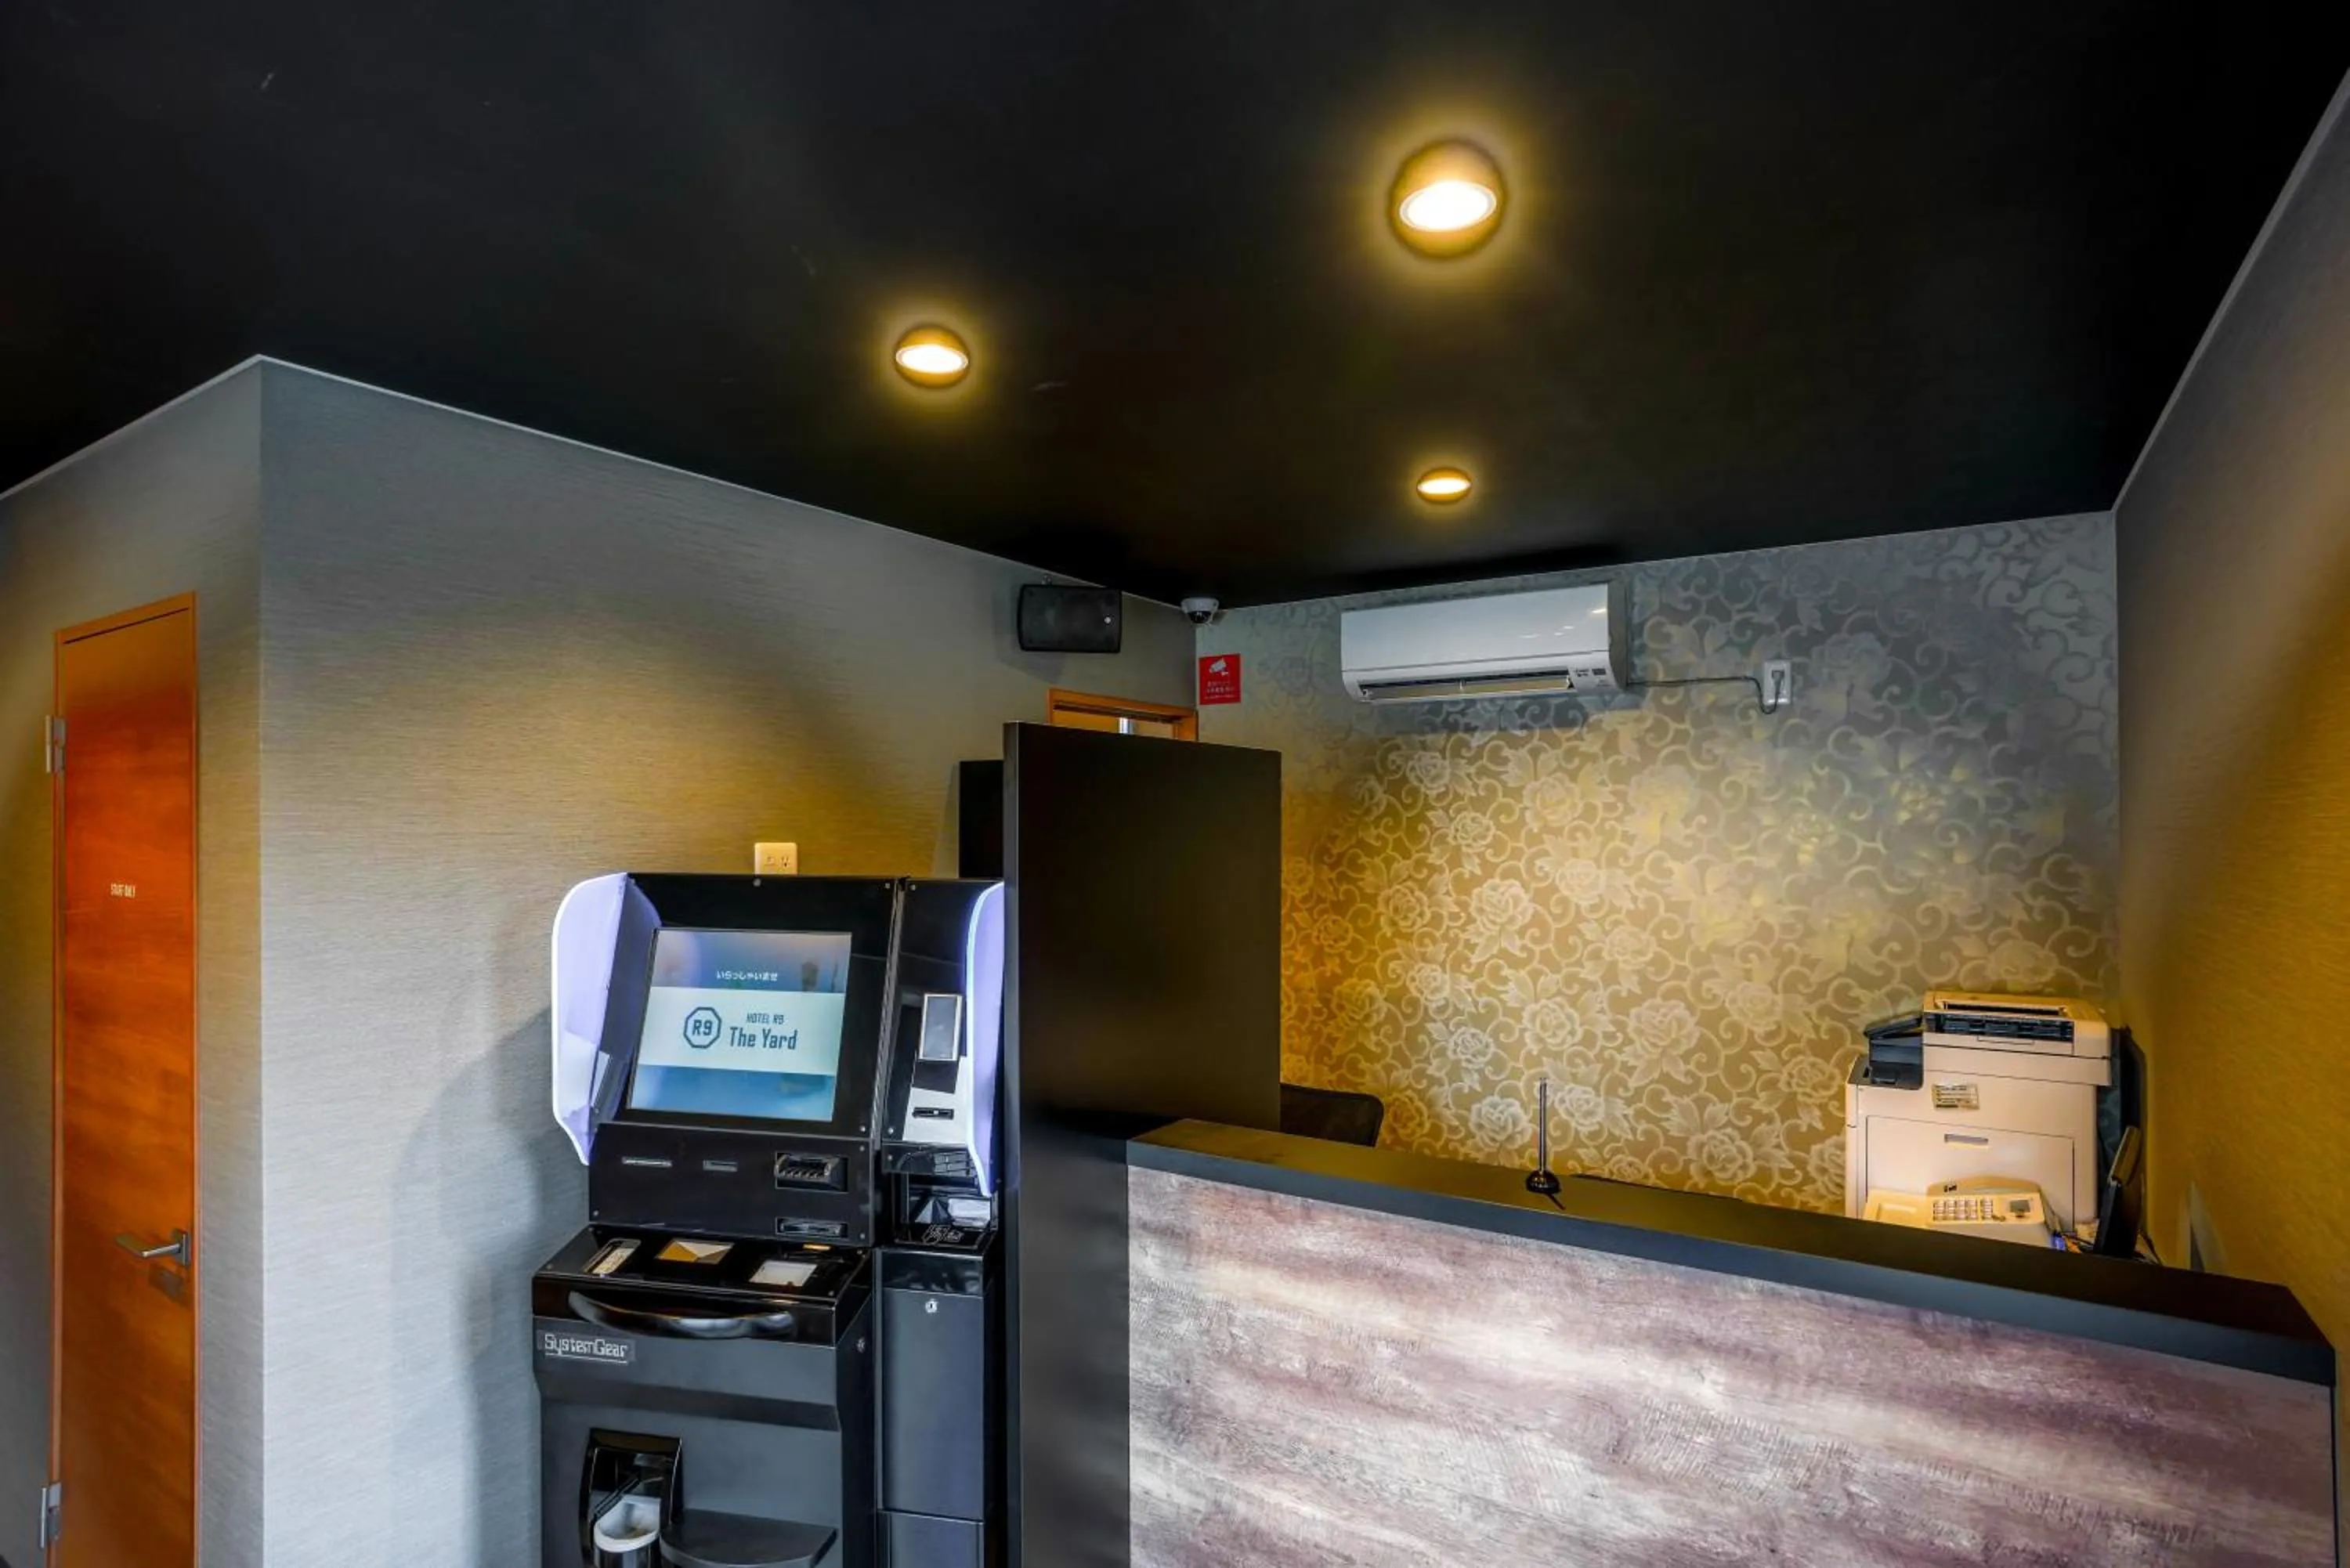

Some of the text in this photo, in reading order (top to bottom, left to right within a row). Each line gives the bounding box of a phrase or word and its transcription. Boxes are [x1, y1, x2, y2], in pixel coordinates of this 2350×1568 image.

[692, 1019, 714, 1036] R9
[747, 1013, 769, 1024] HOTEL
[729, 1027, 798, 1050] The Yard
[544, 1333, 627, 1358] SystemGear
